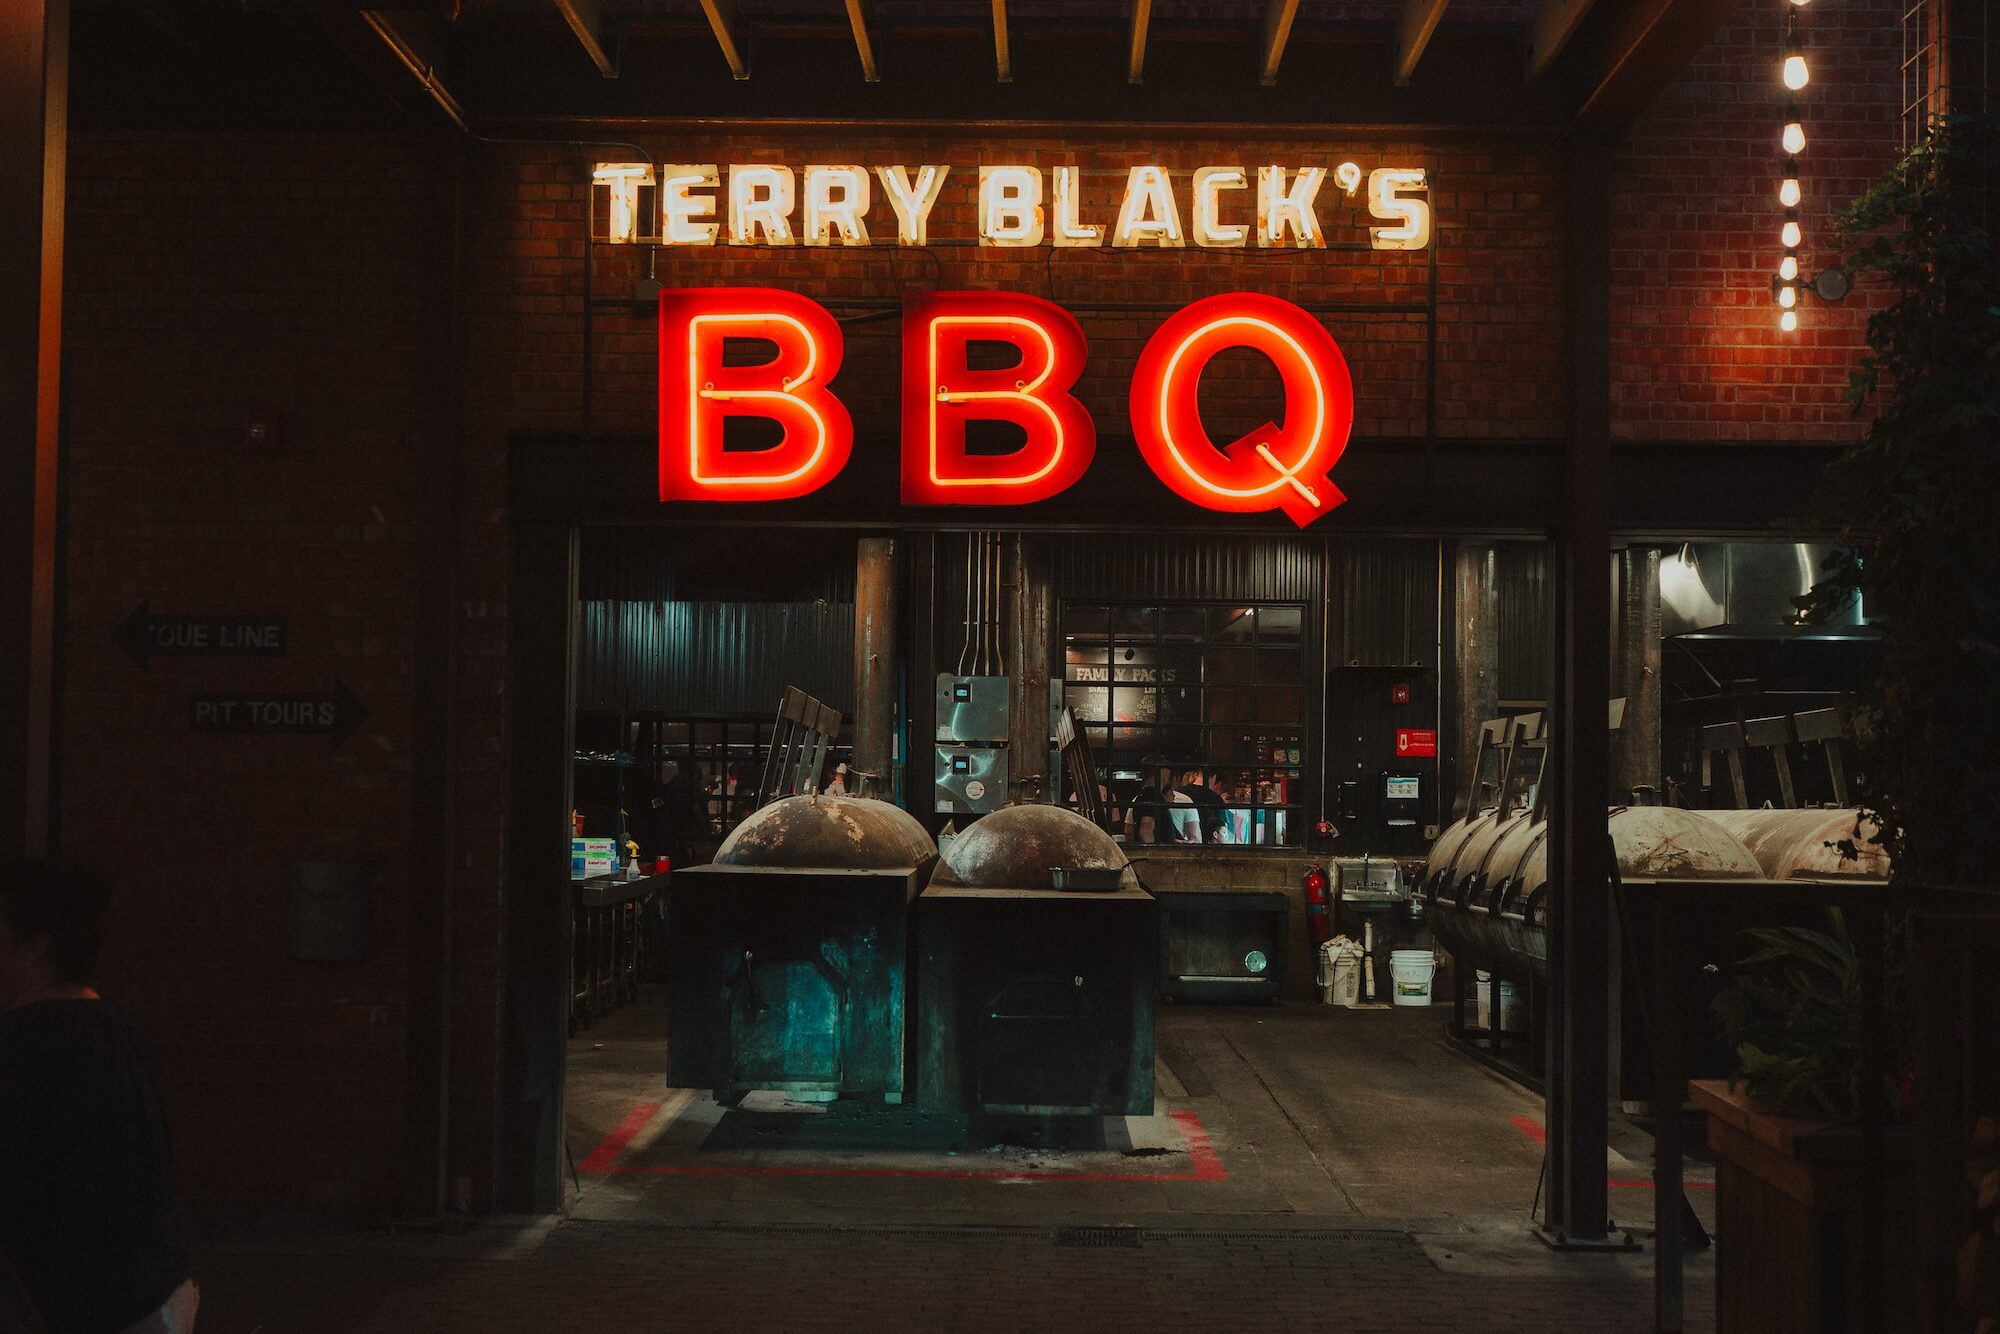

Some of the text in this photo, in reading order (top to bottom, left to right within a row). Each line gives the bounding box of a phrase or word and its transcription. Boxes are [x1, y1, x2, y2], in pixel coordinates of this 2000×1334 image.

[593, 162, 1430, 250] TERRY BLACK'S
[659, 287, 1354, 530] BBQ
[219, 624, 281, 648] LINE
[1076, 667, 1127, 682] FAMIY
[195, 700, 336, 726] PIT TOURS
